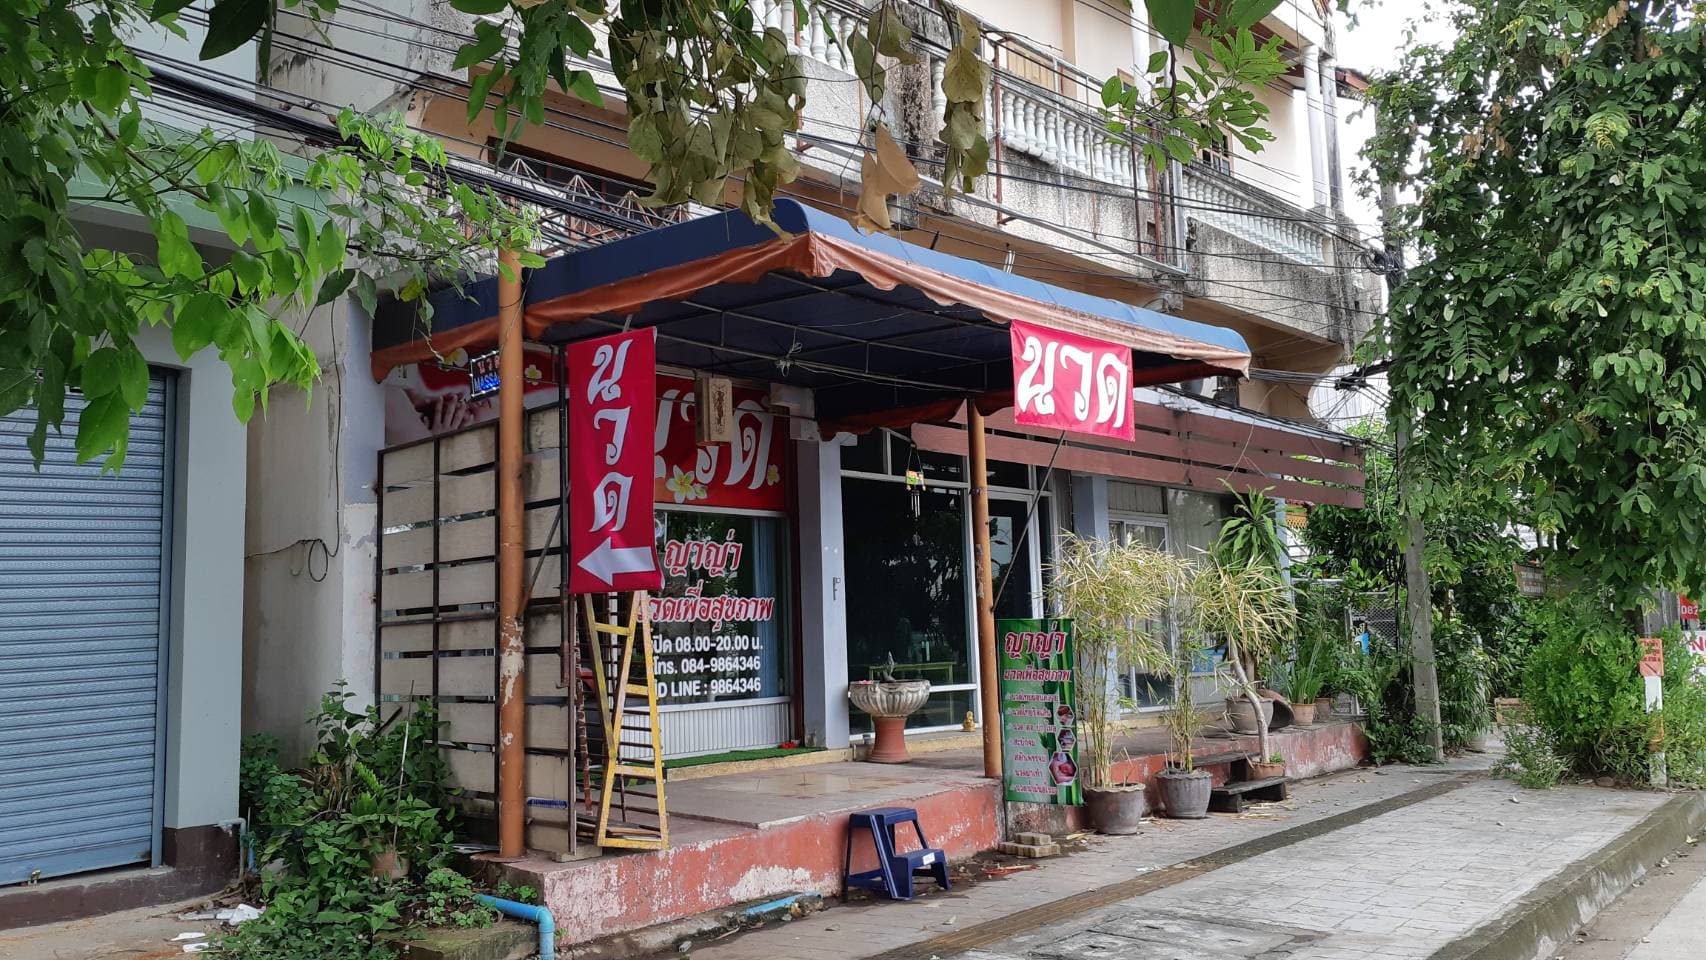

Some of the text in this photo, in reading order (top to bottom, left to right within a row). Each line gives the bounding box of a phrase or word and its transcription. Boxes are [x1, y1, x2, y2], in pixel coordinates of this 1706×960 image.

[474, 371, 501, 392] MASSA
[1017, 336, 1128, 428] นวด
[587, 339, 633, 532] นวด
[664, 528, 743, 577] ญาญ่า
[637, 579, 774, 632] วดเพื่อสุขภาพ
[651, 633, 763, 654] ปิด 08.00-20.00 น.
[1005, 621, 1067, 659] ญาญ่า
[653, 655, 761, 675] โทร. 084-9864346
[671, 679, 701, 697] LINE
[711, 678, 762, 694] 9864346
